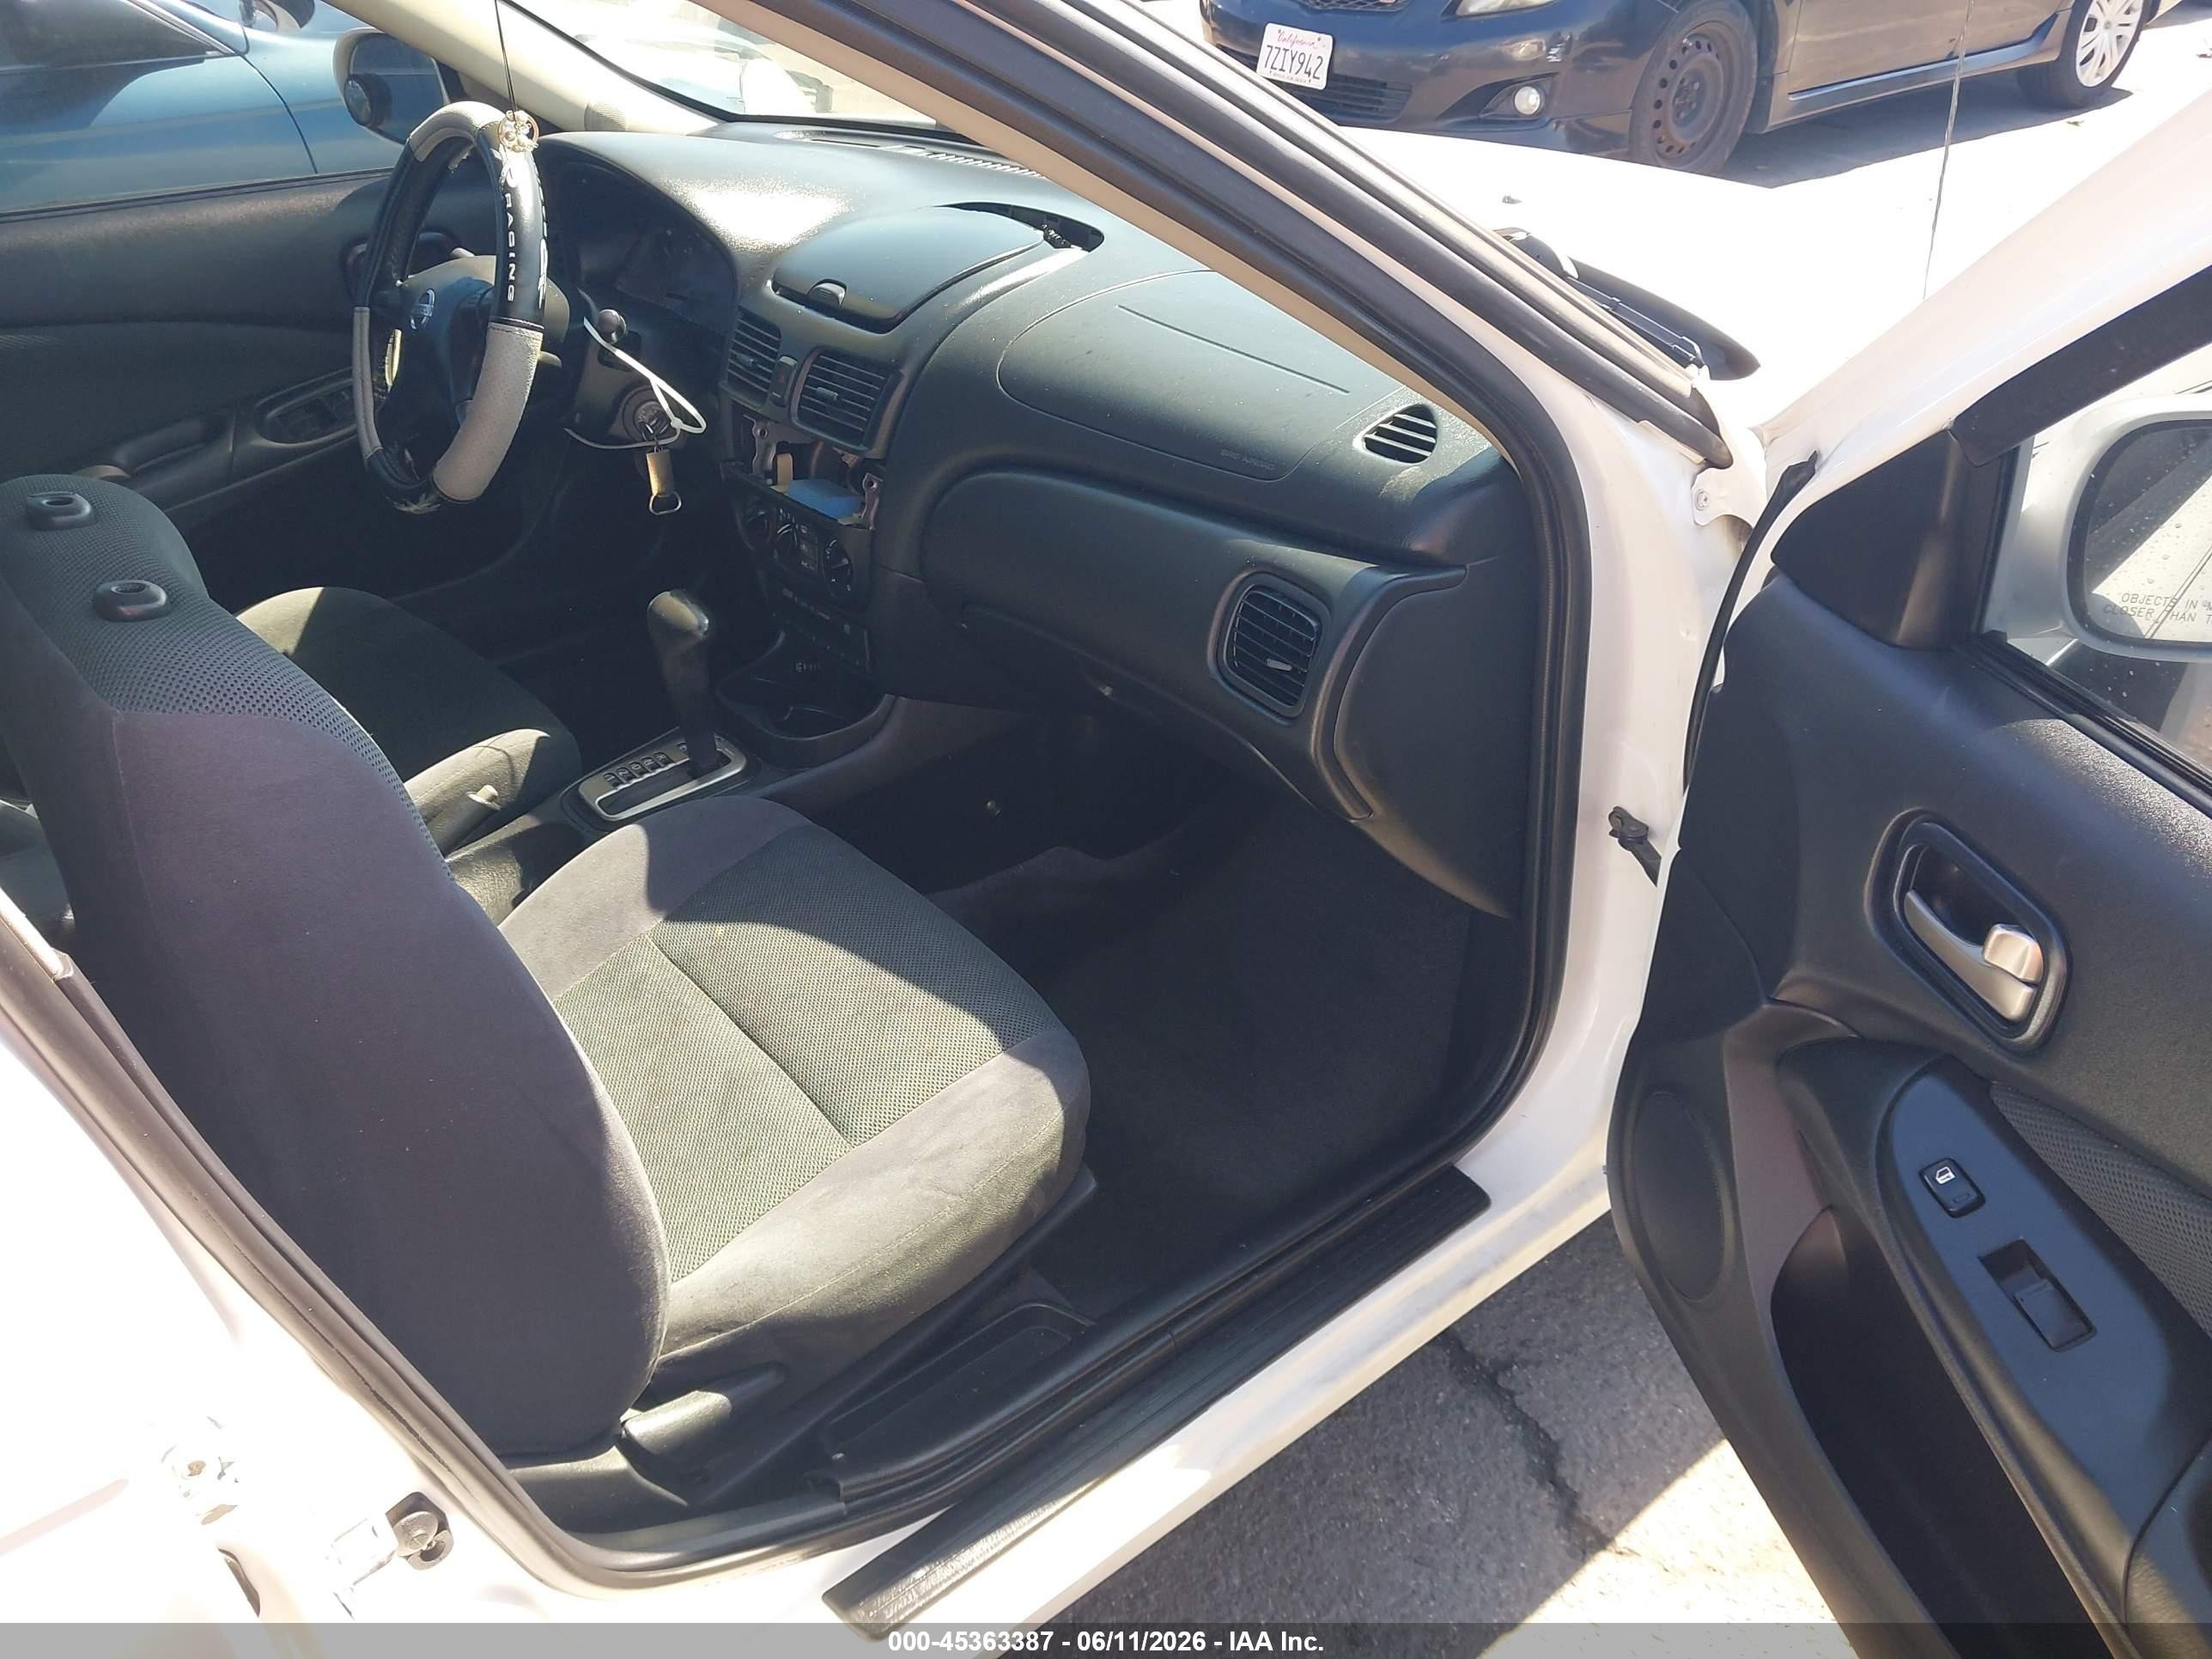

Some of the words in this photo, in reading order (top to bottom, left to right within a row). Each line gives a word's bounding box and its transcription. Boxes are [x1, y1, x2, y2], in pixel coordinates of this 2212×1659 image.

[1265, 45, 1323, 80] 7ZIY942
[2102, 604, 2155, 618] CLOSER
[2185, 599, 2198, 610] IN
